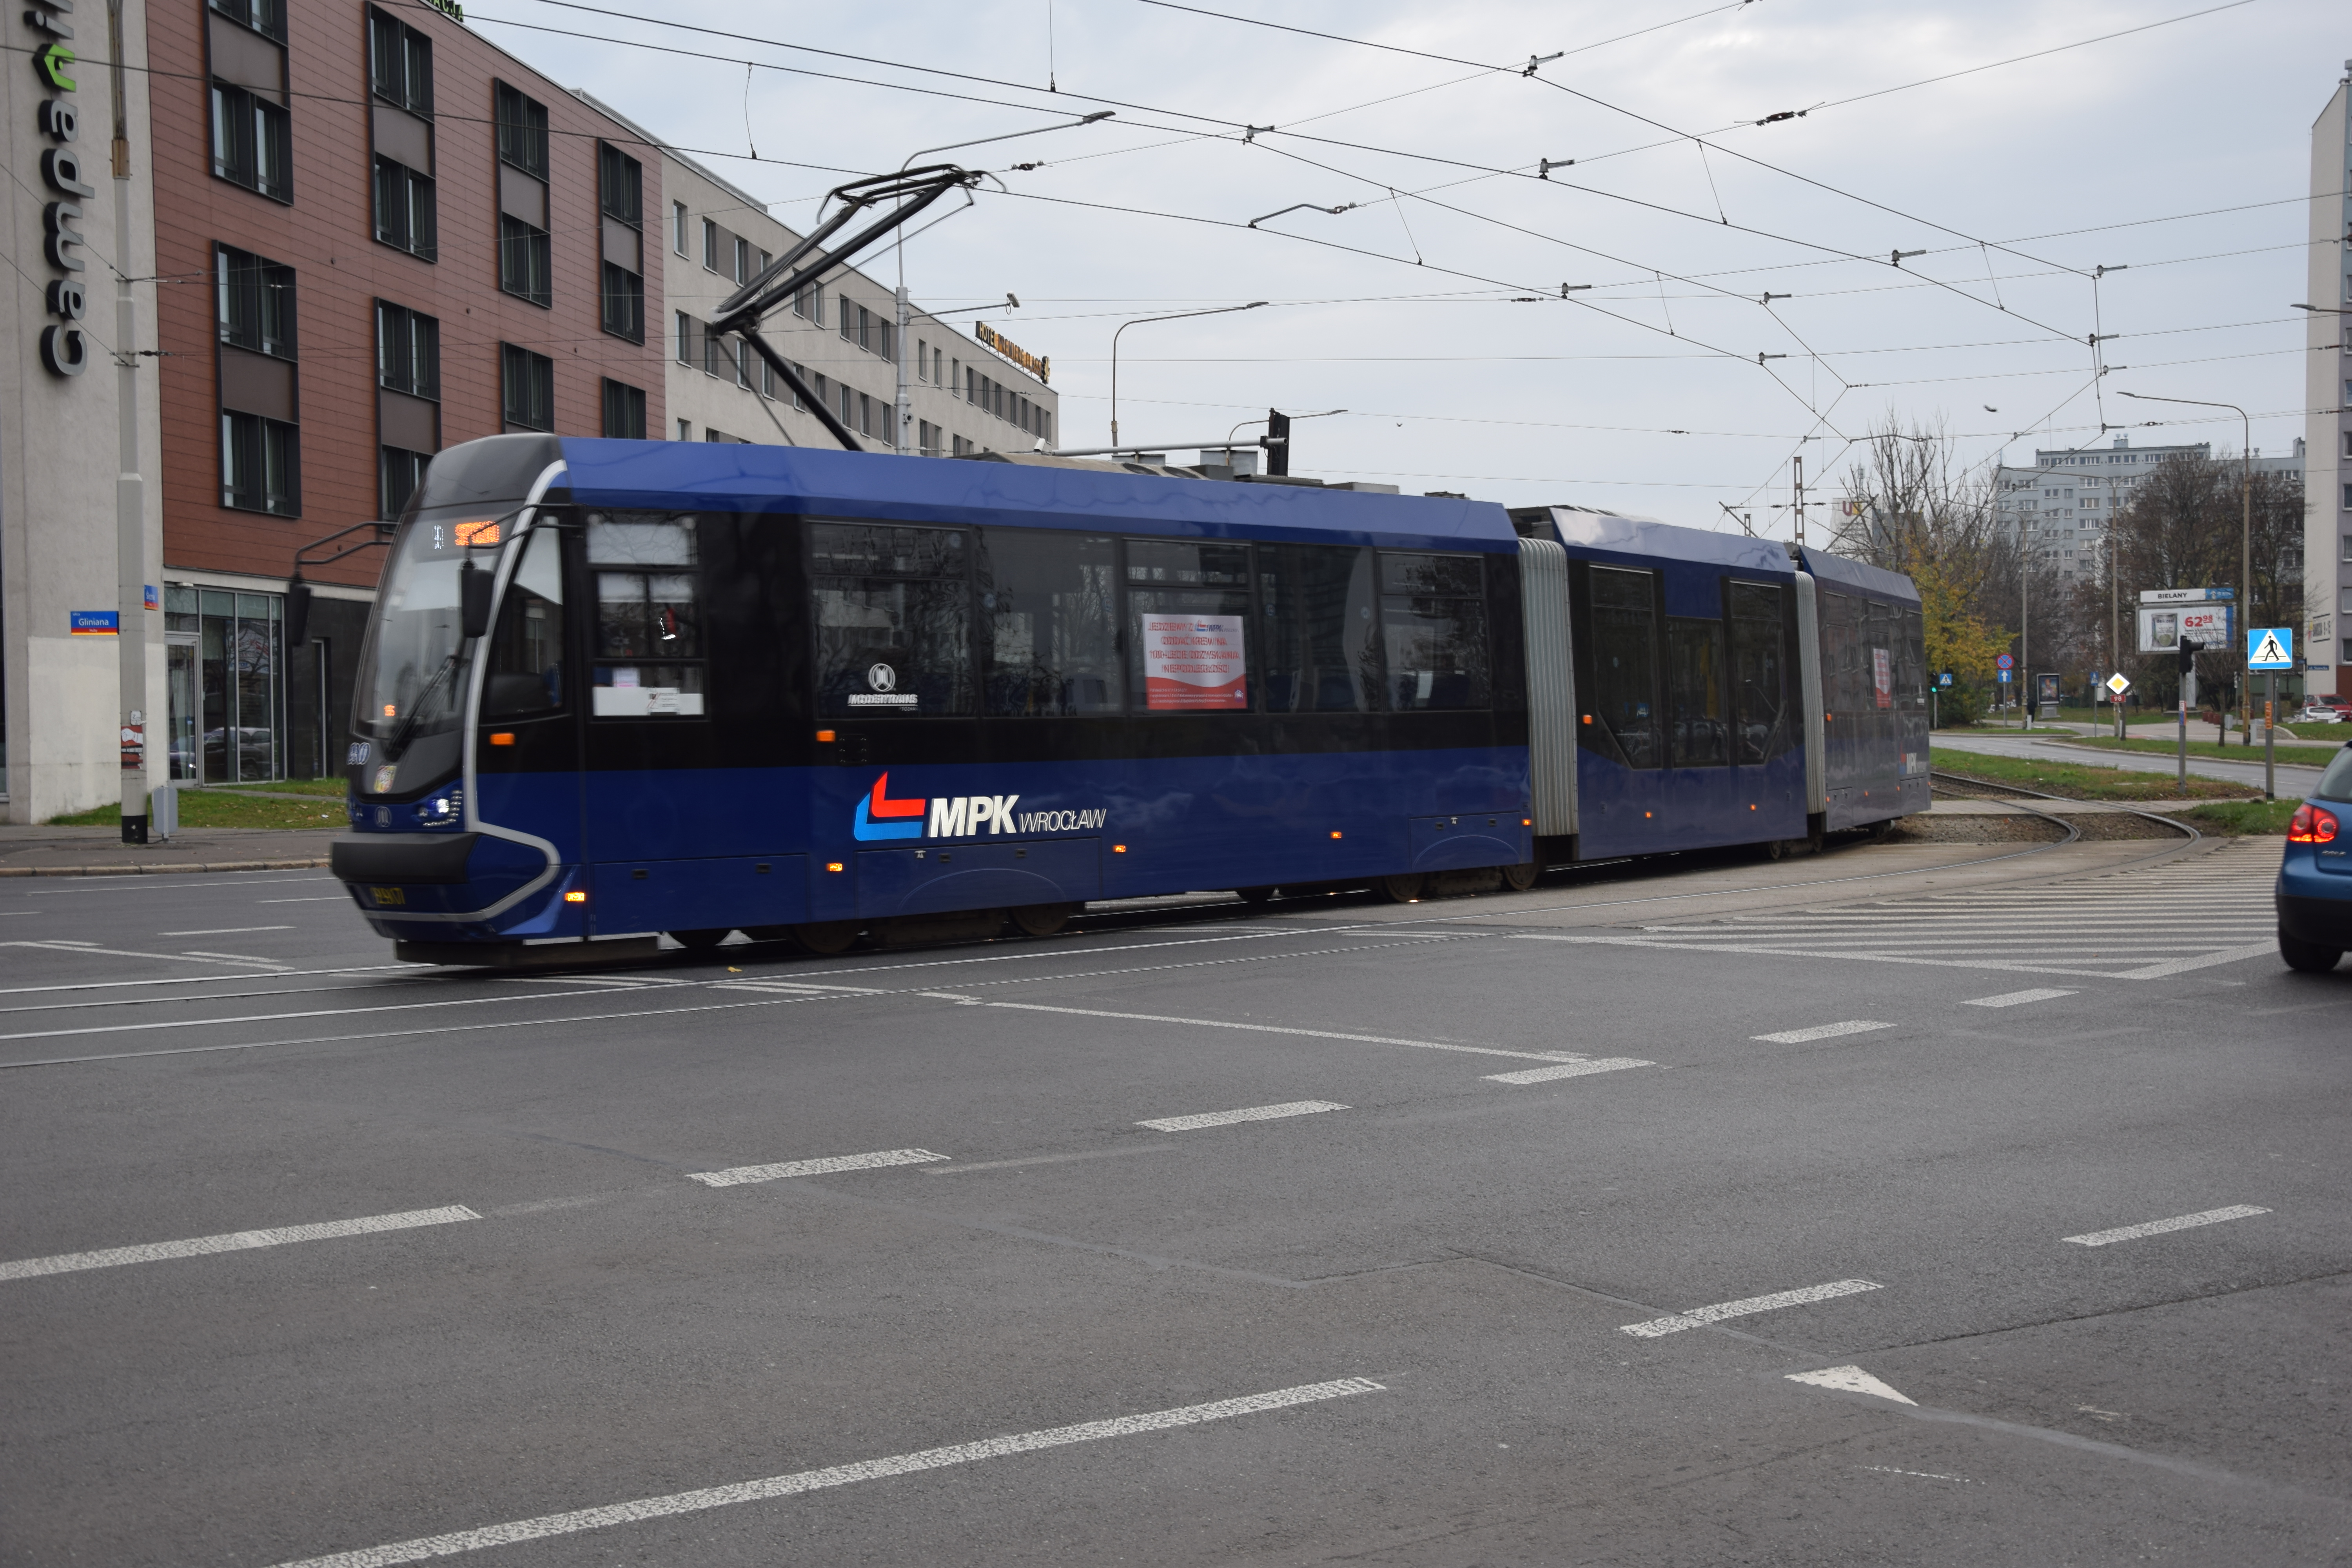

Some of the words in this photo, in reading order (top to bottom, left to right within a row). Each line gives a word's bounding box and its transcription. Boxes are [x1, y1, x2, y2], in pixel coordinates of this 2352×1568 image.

[980, 321, 998, 349] HOTEL
[1207, 624, 1223, 632] MPK
[928, 795, 1020, 838] MPK
[1019, 808, 1107, 833] WROCŁAW
